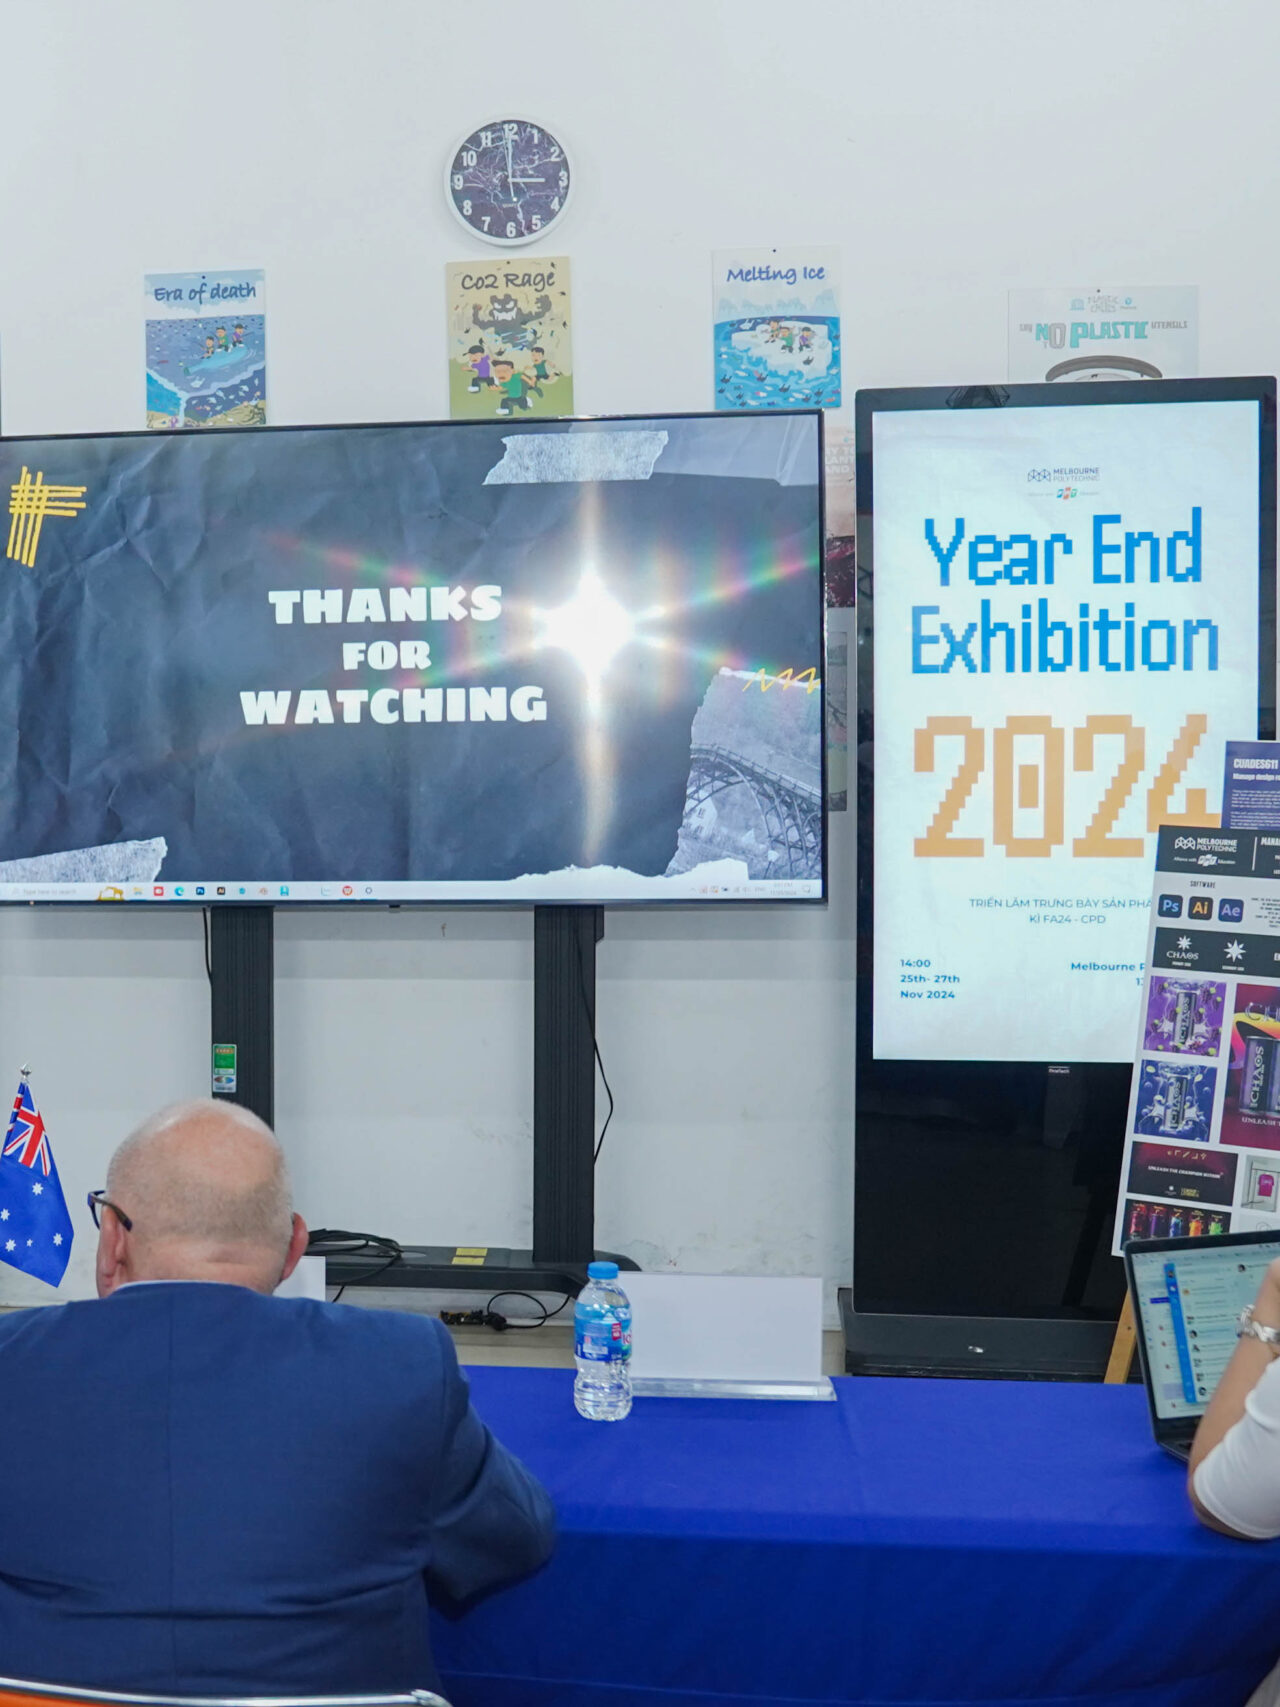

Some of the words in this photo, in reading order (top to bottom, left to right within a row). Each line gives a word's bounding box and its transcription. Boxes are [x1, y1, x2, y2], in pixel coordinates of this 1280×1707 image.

[480, 132, 492, 147] 11
[503, 124, 519, 140] 12
[532, 129, 540, 144] 1
[461, 151, 477, 167] 10
[550, 146, 562, 161] 2
[453, 175, 464, 190] 9
[558, 171, 569, 187] 3
[463, 200, 473, 216] 8
[550, 196, 560, 212] 4
[481, 216, 491, 232] 7
[506, 222, 517, 237] 6
[531, 215, 541, 230] 5
[461, 273, 499, 290] Co2
[503, 272, 556, 292] Rage
[726, 265, 797, 285] Melting
[803, 266, 826, 280] Ice
[154, 287, 184, 301] Era
[188, 282, 208, 305] of
[210, 282, 257, 299] death
[1070, 321, 1148, 348] PLASTIC
[1053, 467, 1100, 475] MELBOURNE
[925, 518, 1072, 586] Year
[1092, 507, 1202, 584] End
[268, 584, 503, 626] THANKS
[911, 598, 1219, 674] Exhibition
[342, 640, 431, 671] FOR
[238, 686, 548, 725] WATCHING
[914, 714, 1220, 858] 2024
[1196, 844, 1237, 853] POLYTECHNIC
[1197, 837, 1238, 847] MELBOURNE
[1190, 880, 1216, 889] SOFTWARE
[1163, 899, 1179, 912] Ps
[1192, 901, 1209, 914] Ai
[1221, 903, 1241, 916] Ae
[1043, 915, 1071, 923] FA24
[1081, 915, 1107, 924] CPD
[1166, 950, 1200, 960] CHAOS
[900, 959, 931, 968] 14:00
[1071, 962, 1136, 971] Melbourne
[936, 975, 960, 984] 27th
[900, 990, 923, 999] Nov
[927, 990, 955, 999] 2024
